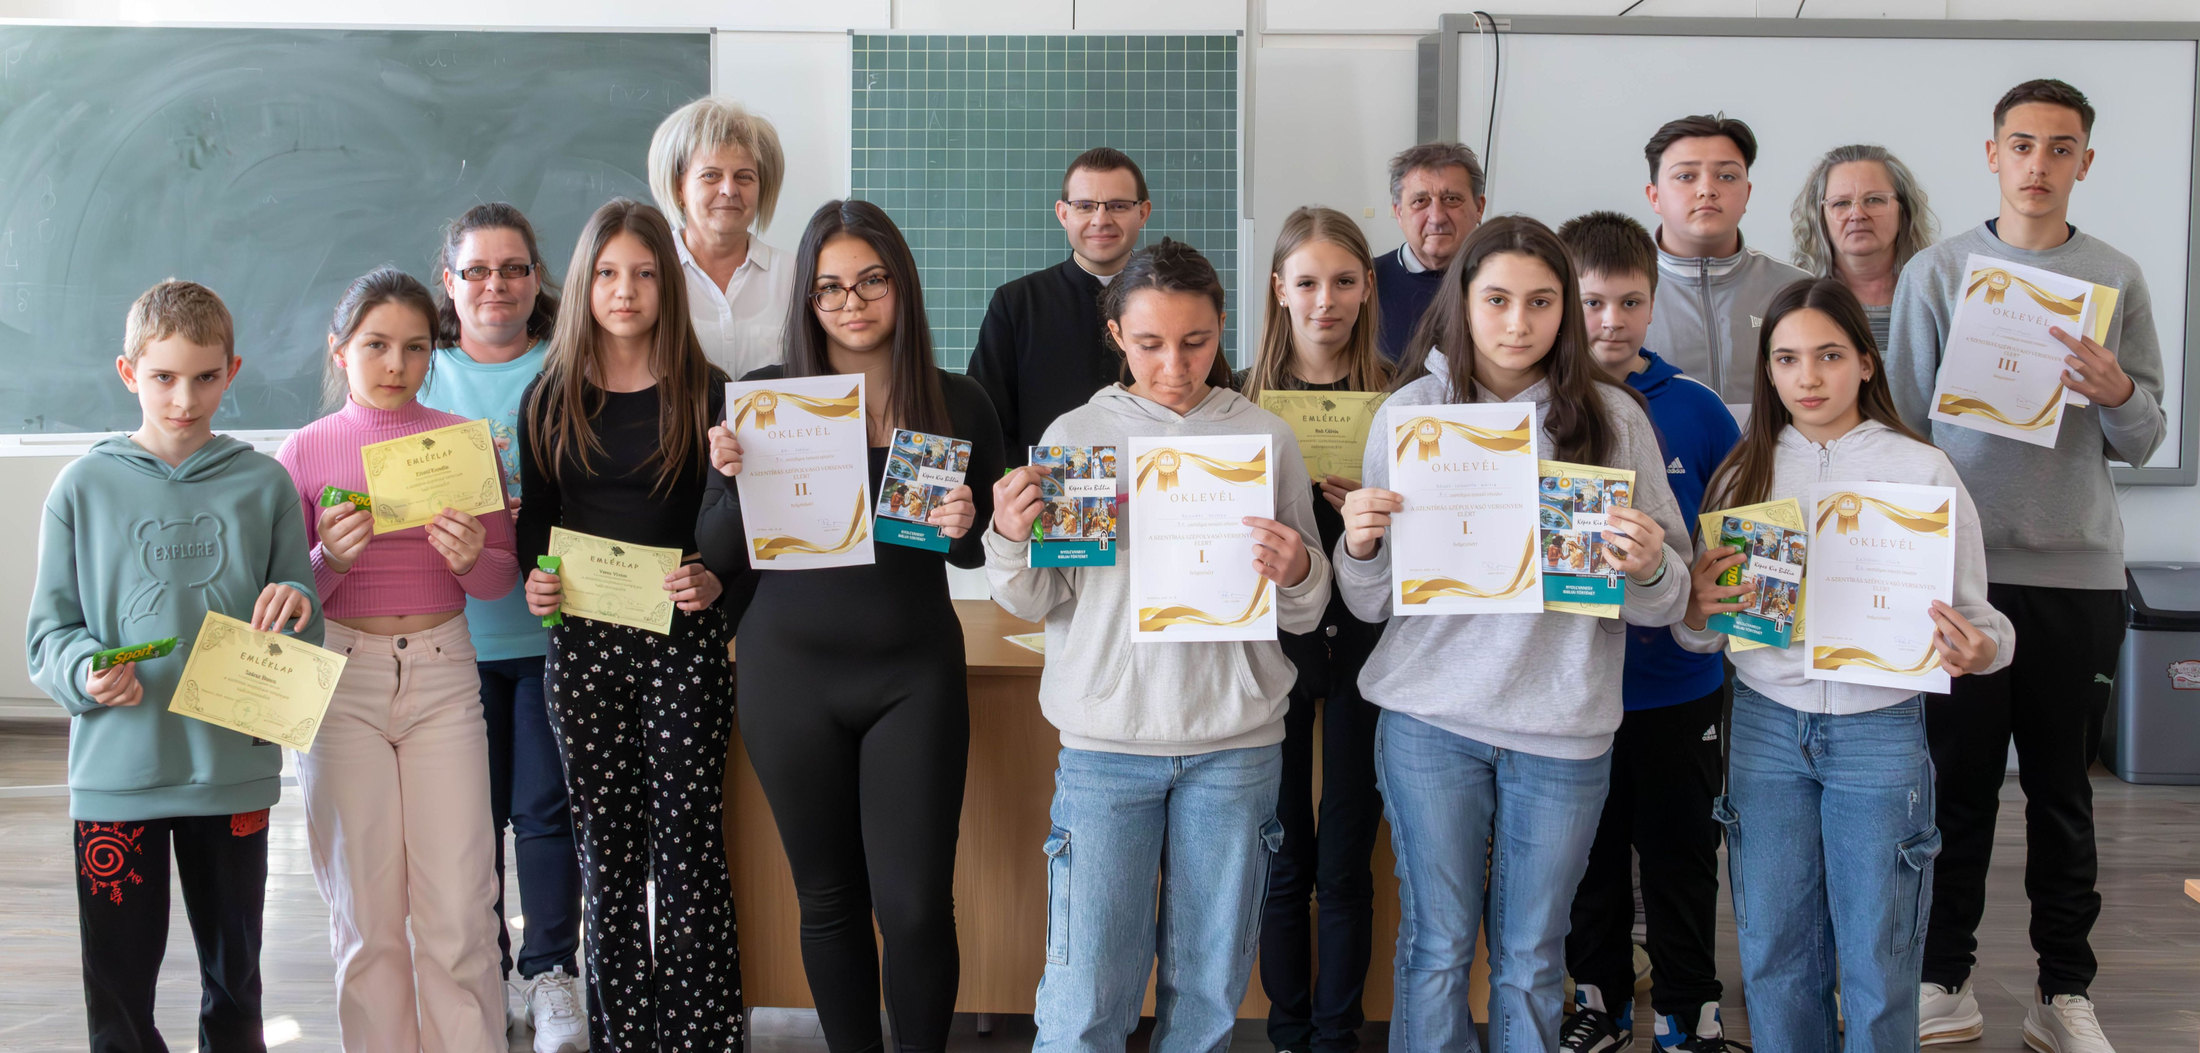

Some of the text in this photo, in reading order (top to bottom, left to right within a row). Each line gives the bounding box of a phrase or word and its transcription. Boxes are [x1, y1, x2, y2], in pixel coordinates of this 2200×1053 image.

[1992, 307, 2050, 327] OKLEVÉL
[1998, 357, 2020, 373] III.
[1302, 414, 1351, 422] EMLÉKLAP
[767, 426, 831, 439] OKLEVÉL
[406, 449, 452, 466] EMLÉKLAP
[1431, 458, 1499, 473] OKLEVÉL
[795, 482, 812, 496] II.
[1169, 489, 1235, 503] OKLEVÉL
[1463, 520, 1473, 534] I.
[1849, 536, 1915, 550] OKLEVÉL
[153, 542, 215, 561] EXPLORE
[1199, 549, 1209, 563] I.
[590, 555, 639, 569] EMLÉKLAP
[1873, 594, 1890, 610] II.
[112, 643, 155, 665] Sport
[240, 651, 293, 674] EMLÉKLAP
